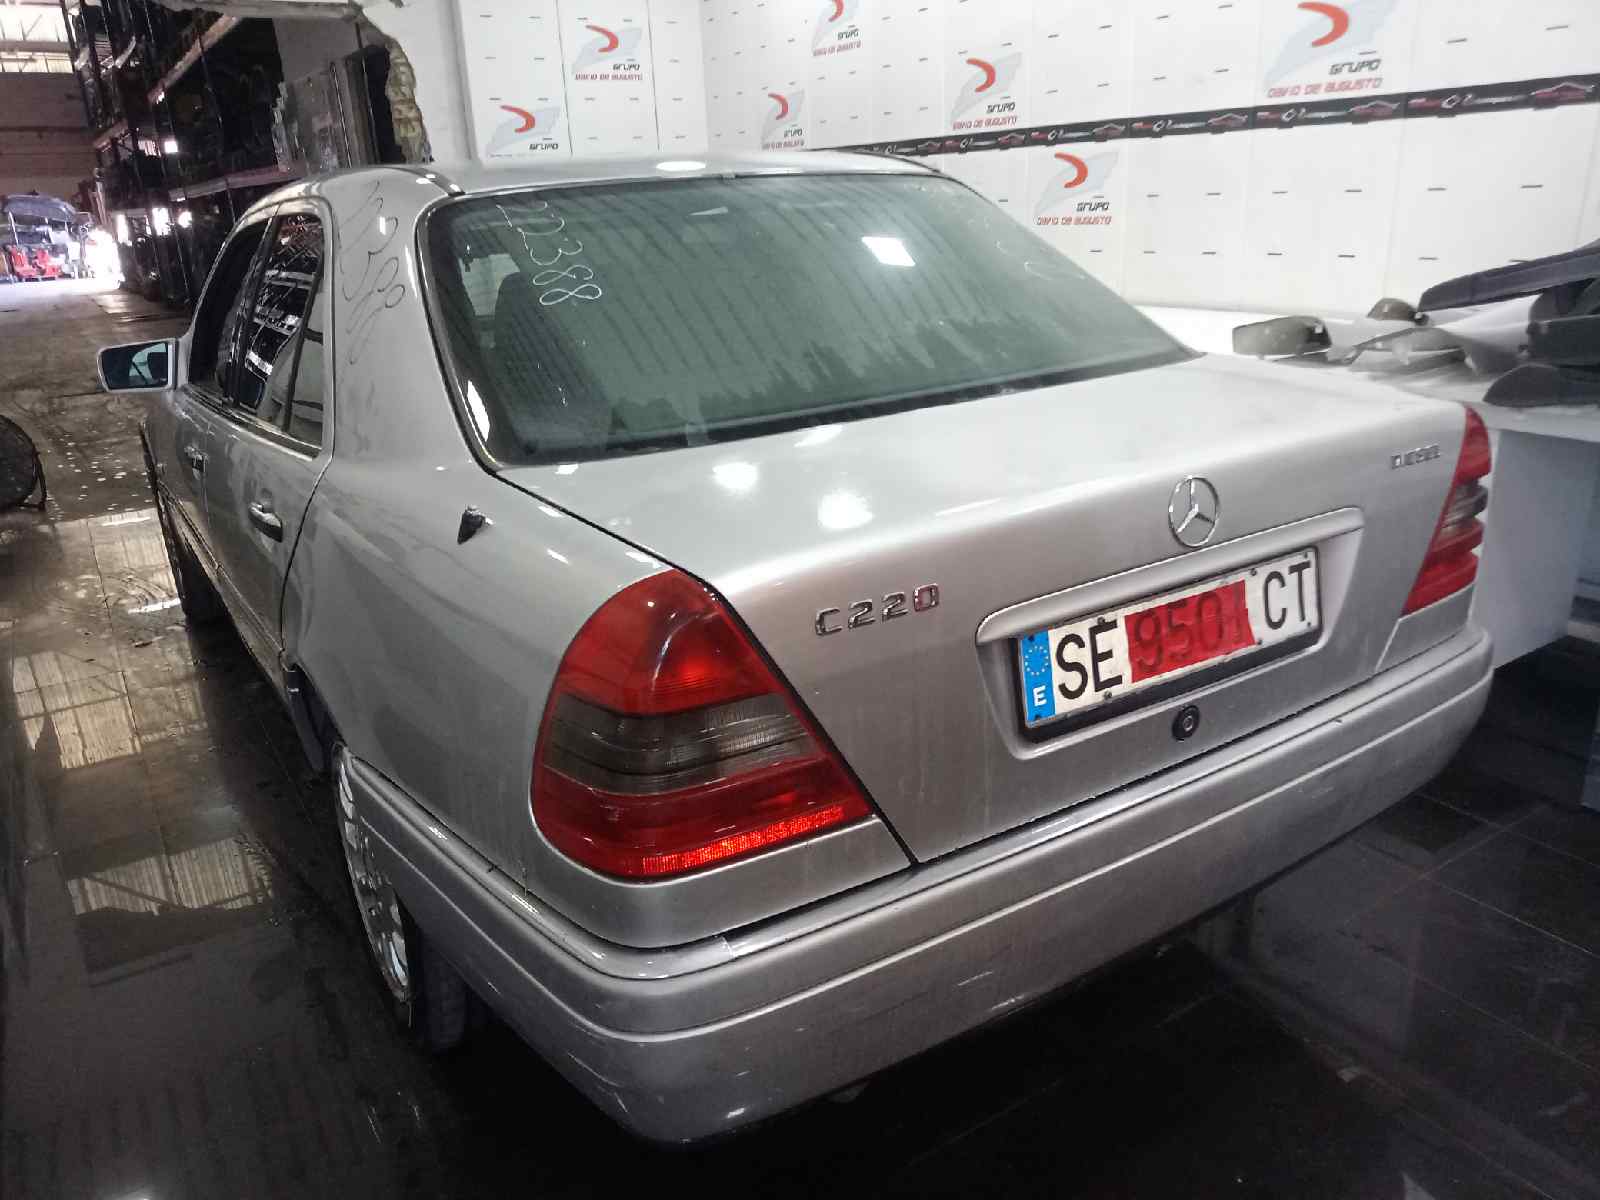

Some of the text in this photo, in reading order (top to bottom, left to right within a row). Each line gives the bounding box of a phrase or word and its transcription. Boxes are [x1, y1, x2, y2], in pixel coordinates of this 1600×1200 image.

[1328, 58, 1383, 75] GRUPO
[814, 582, 940, 636] C220
[1055, 615, 1124, 701] SE
[1262, 560, 1312, 630] CT
[1032, 684, 1048, 708] E
